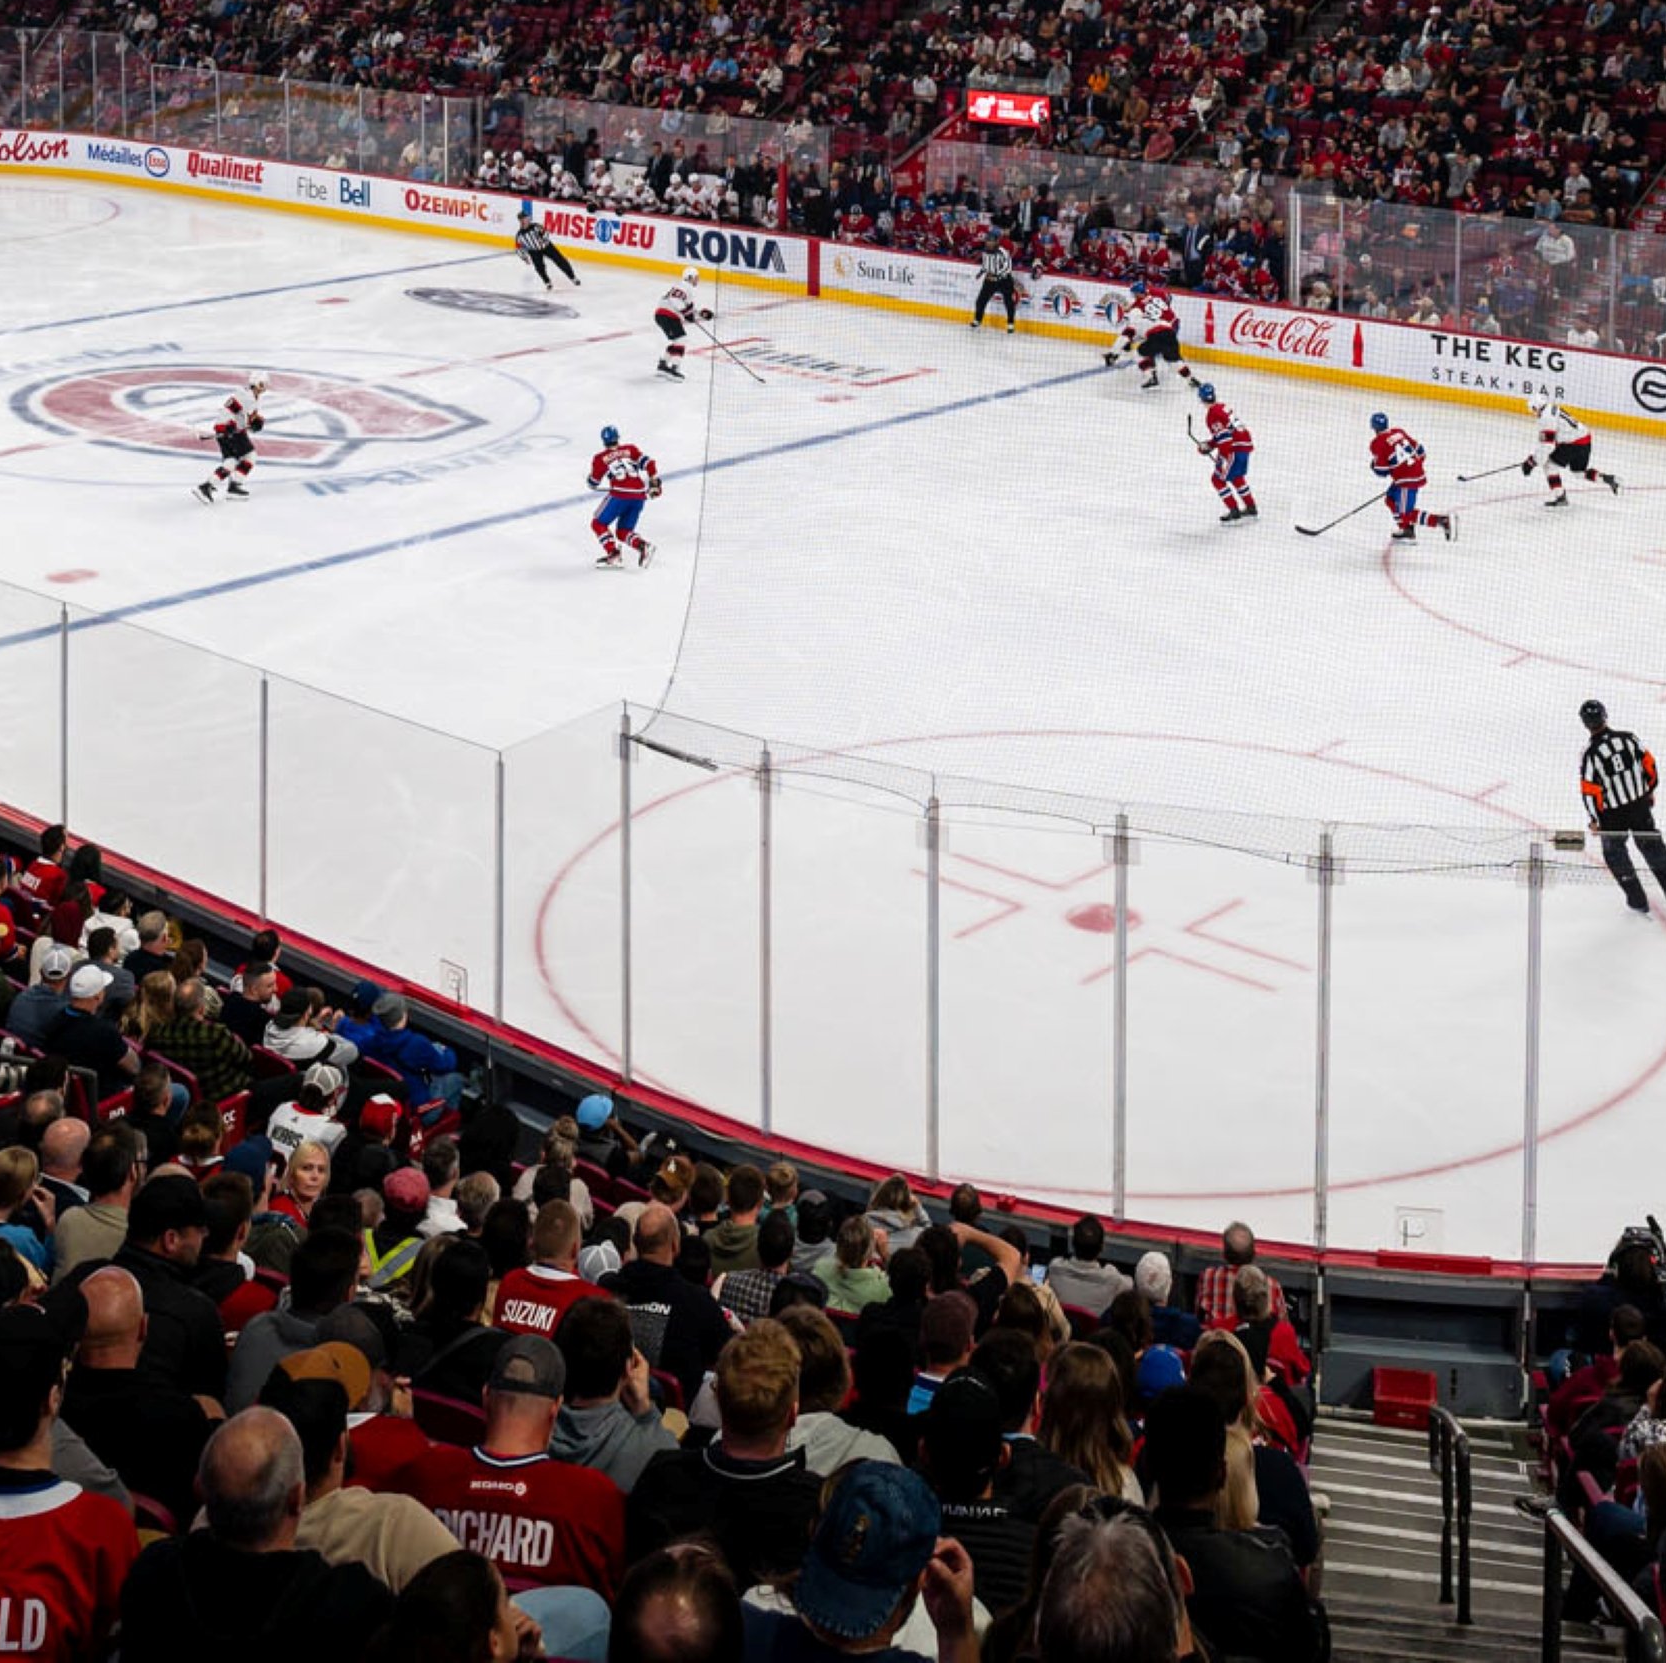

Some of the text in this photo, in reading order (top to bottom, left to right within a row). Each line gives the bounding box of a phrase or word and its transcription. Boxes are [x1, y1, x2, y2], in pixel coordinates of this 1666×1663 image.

[88, 143, 143, 168] Médailles
[187, 152, 264, 184] Qualinet
[297, 177, 370, 207] Fibe Bell
[677, 226, 785, 273] RONA
[858, 259, 885, 282] Sun
[888, 262, 914, 286] Life
[1431, 334, 1565, 372] THE KEG
[1432, 367, 1565, 400] STEAK BAR
[502, 1297, 557, 1334] SUZUKI
